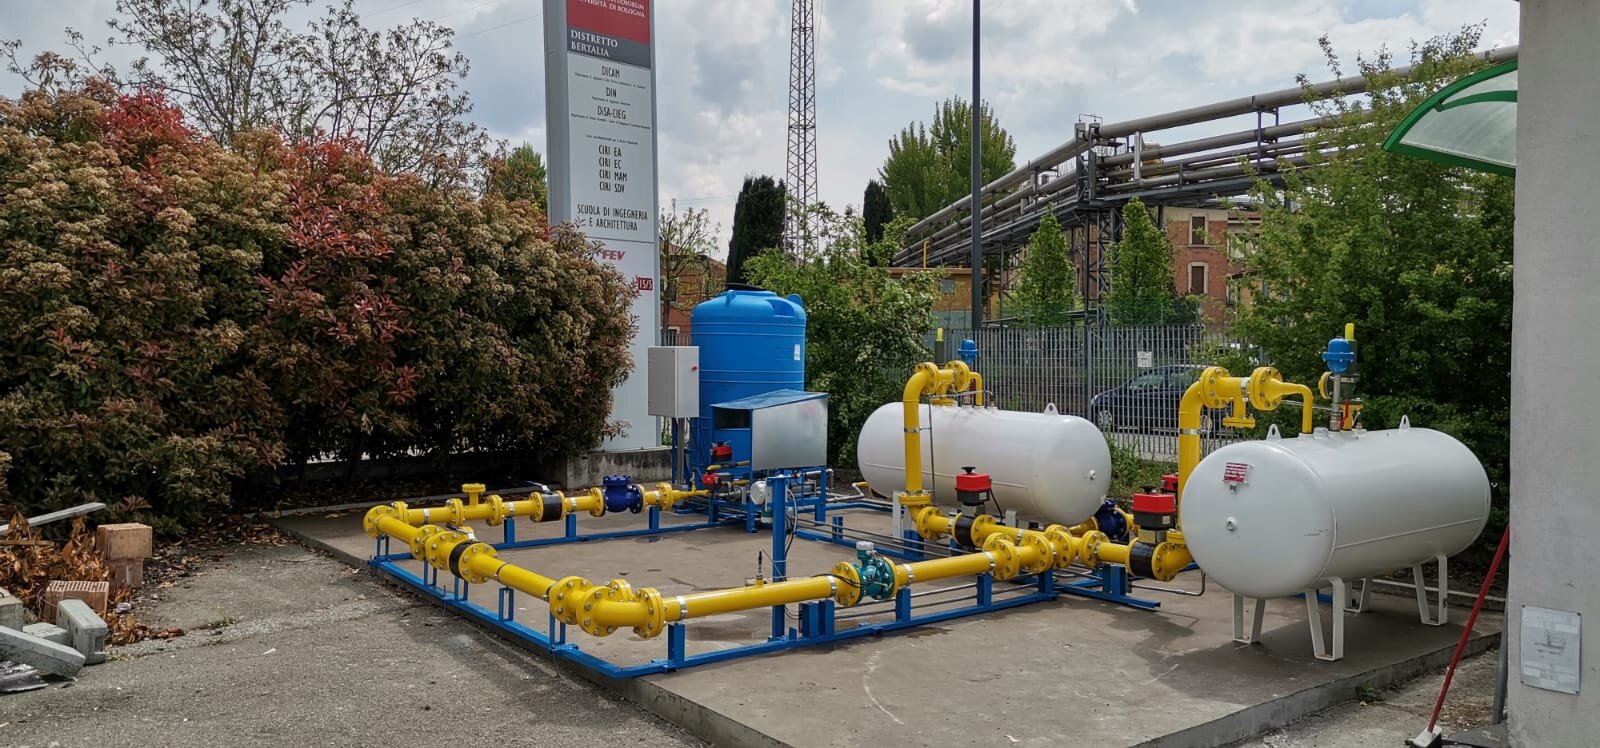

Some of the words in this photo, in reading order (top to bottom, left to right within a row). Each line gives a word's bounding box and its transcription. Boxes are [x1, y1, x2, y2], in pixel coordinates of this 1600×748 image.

[618, 5, 645, 18] BOLOGNA
[571, 29, 618, 48] DISTRETTO
[571, 40, 609, 56] BERTALIA
[602, 66, 620, 78] DICAM
[606, 86, 616, 98] DIN
[598, 144, 610, 156] CIRI
[614, 146, 622, 158] EA
[598, 156, 610, 168] CIRI
[614, 159, 622, 170] EC
[598, 168, 611, 180] CIRI
[614, 172, 628, 182] MAM
[599, 181, 611, 192] CIRI
[577, 204, 600, 216] SCUOLA
[603, 206, 610, 216] DI
[612, 208, 648, 220] INGEGNERIA
[589, 218, 593, 227] E
[596, 218, 638, 231] ARCHITETTURA
[602, 249, 626, 260] FEV
